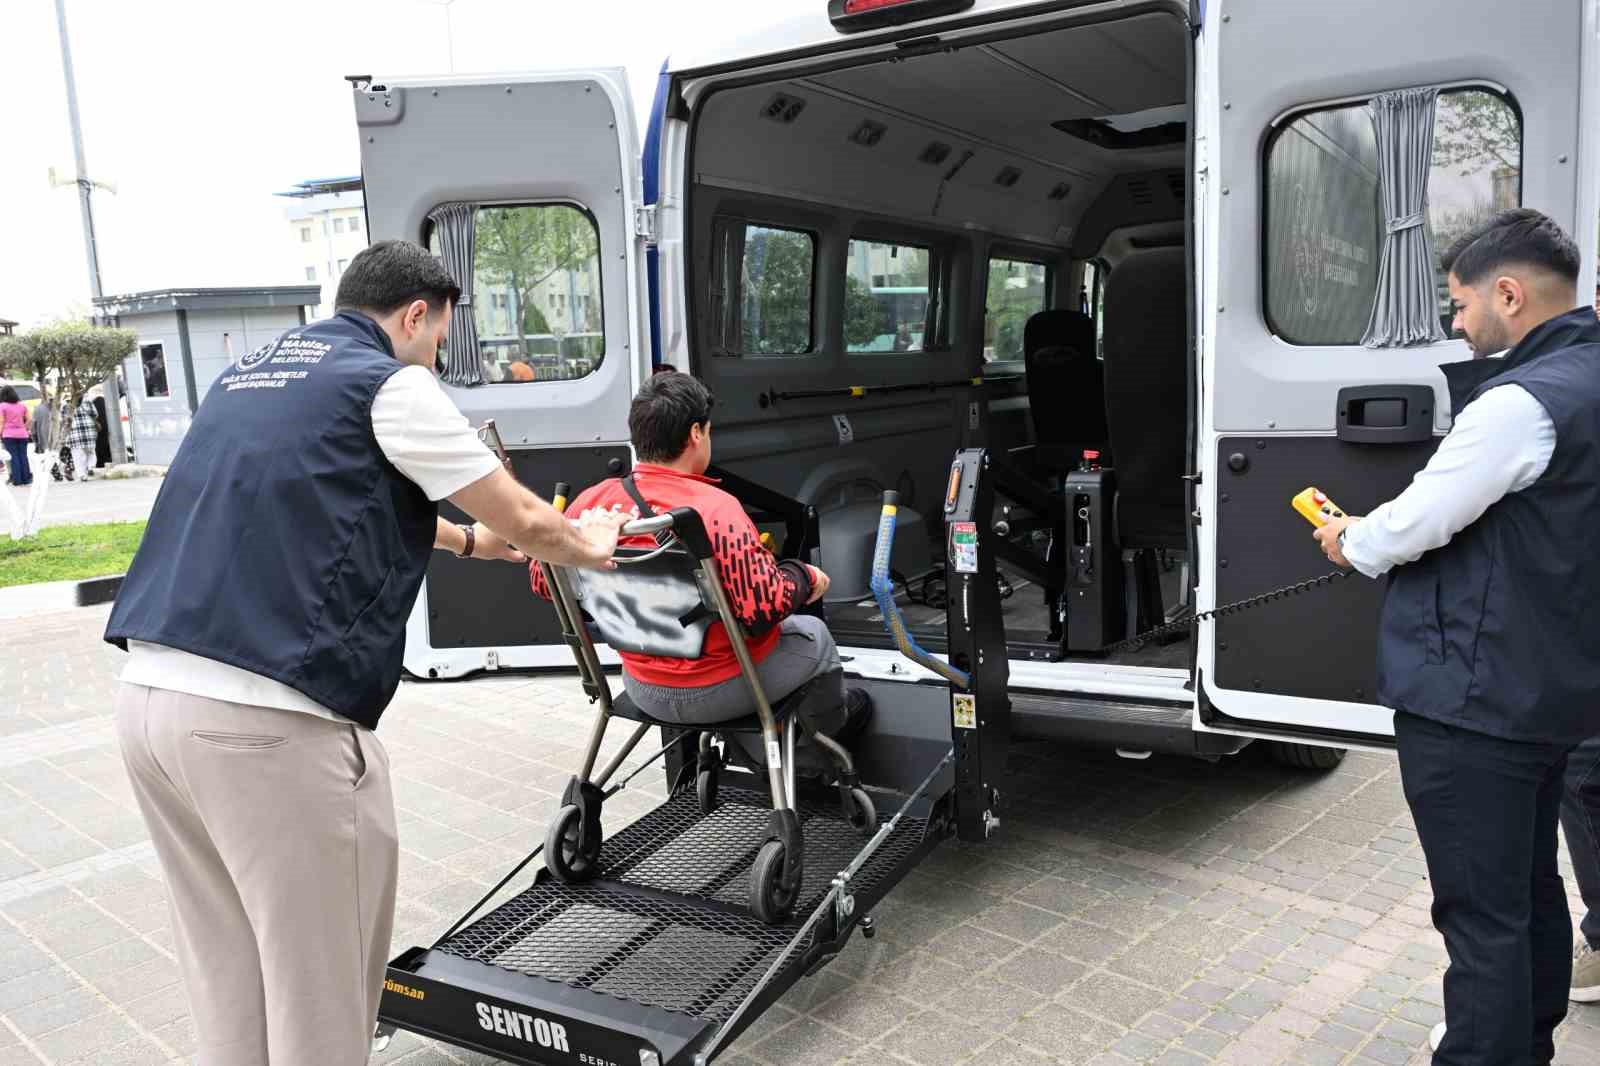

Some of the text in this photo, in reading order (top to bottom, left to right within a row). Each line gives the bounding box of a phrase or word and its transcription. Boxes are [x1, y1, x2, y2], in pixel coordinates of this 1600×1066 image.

[281, 340, 332, 352] MANİSA
[475, 1001, 570, 1053] SENTOR
[579, 1052, 622, 1066] SERI
